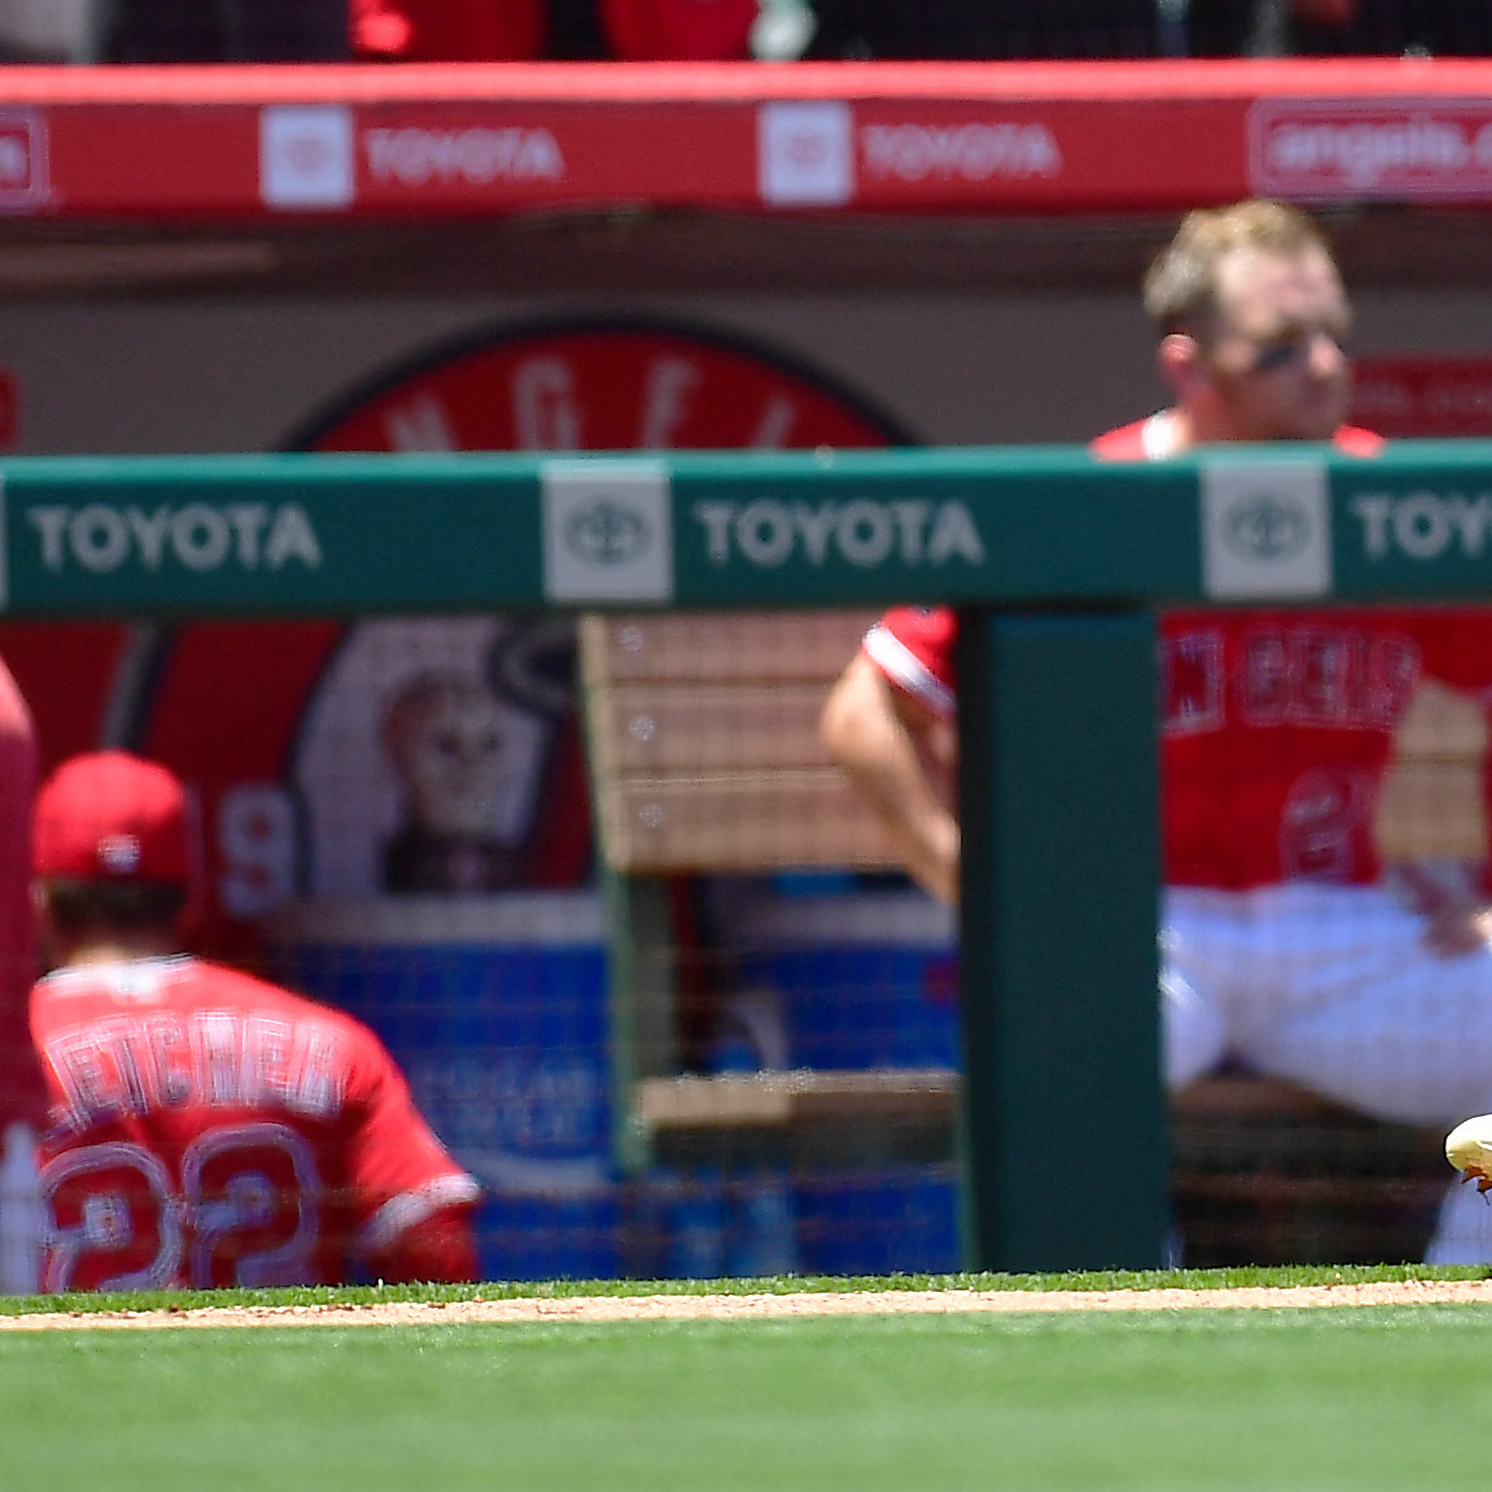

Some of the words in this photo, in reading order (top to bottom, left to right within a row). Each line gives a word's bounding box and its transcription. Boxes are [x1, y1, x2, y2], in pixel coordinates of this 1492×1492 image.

[364, 127, 567, 184] TOYOTA
[863, 122, 1063, 180] TOYOTA
[24, 501, 323, 573] TOYOTA
[694, 496, 987, 568] TOYOTA
[1163, 626, 1425, 730] NGELS
[48, 1008, 350, 1136] ETCHER
[38, 1120, 323, 1292] 22
